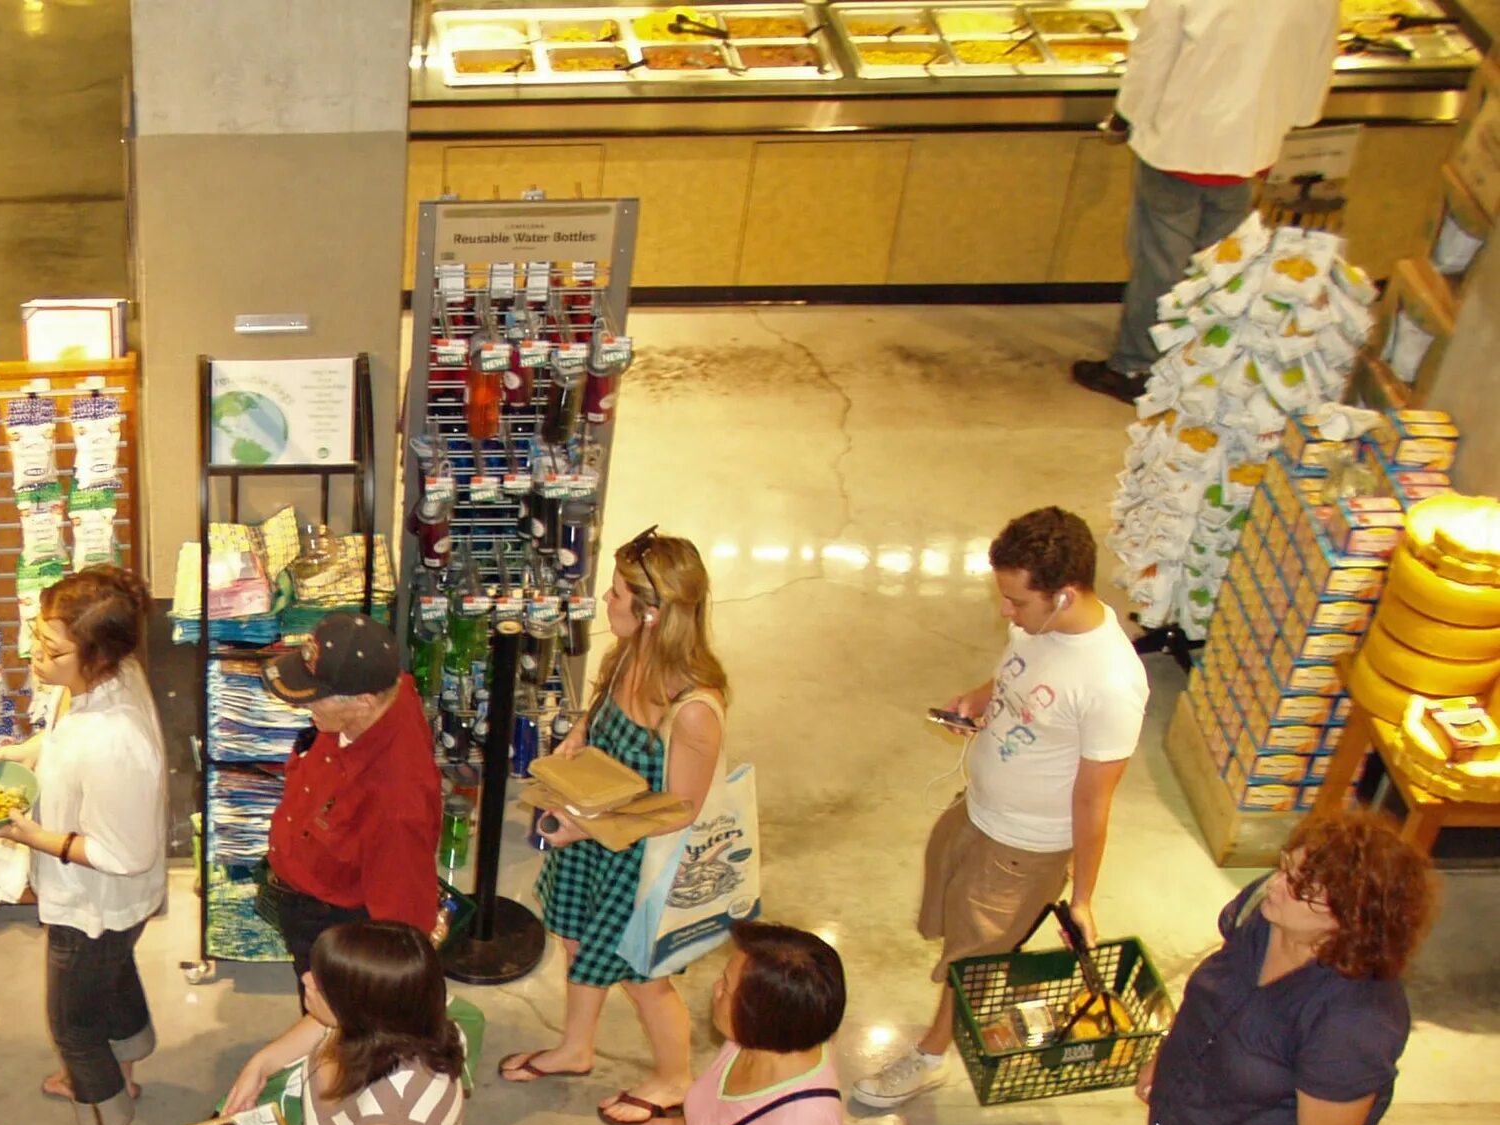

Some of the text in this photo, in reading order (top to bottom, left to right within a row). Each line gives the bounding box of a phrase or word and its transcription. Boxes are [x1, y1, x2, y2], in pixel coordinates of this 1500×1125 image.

[454, 231, 596, 244] Reusable Water Bottles
[437, 354, 464, 364] NEW!
[521, 355, 547, 367] NEW!
[602, 351, 629, 362] NEW!
[483, 358, 508, 370] NEW!
